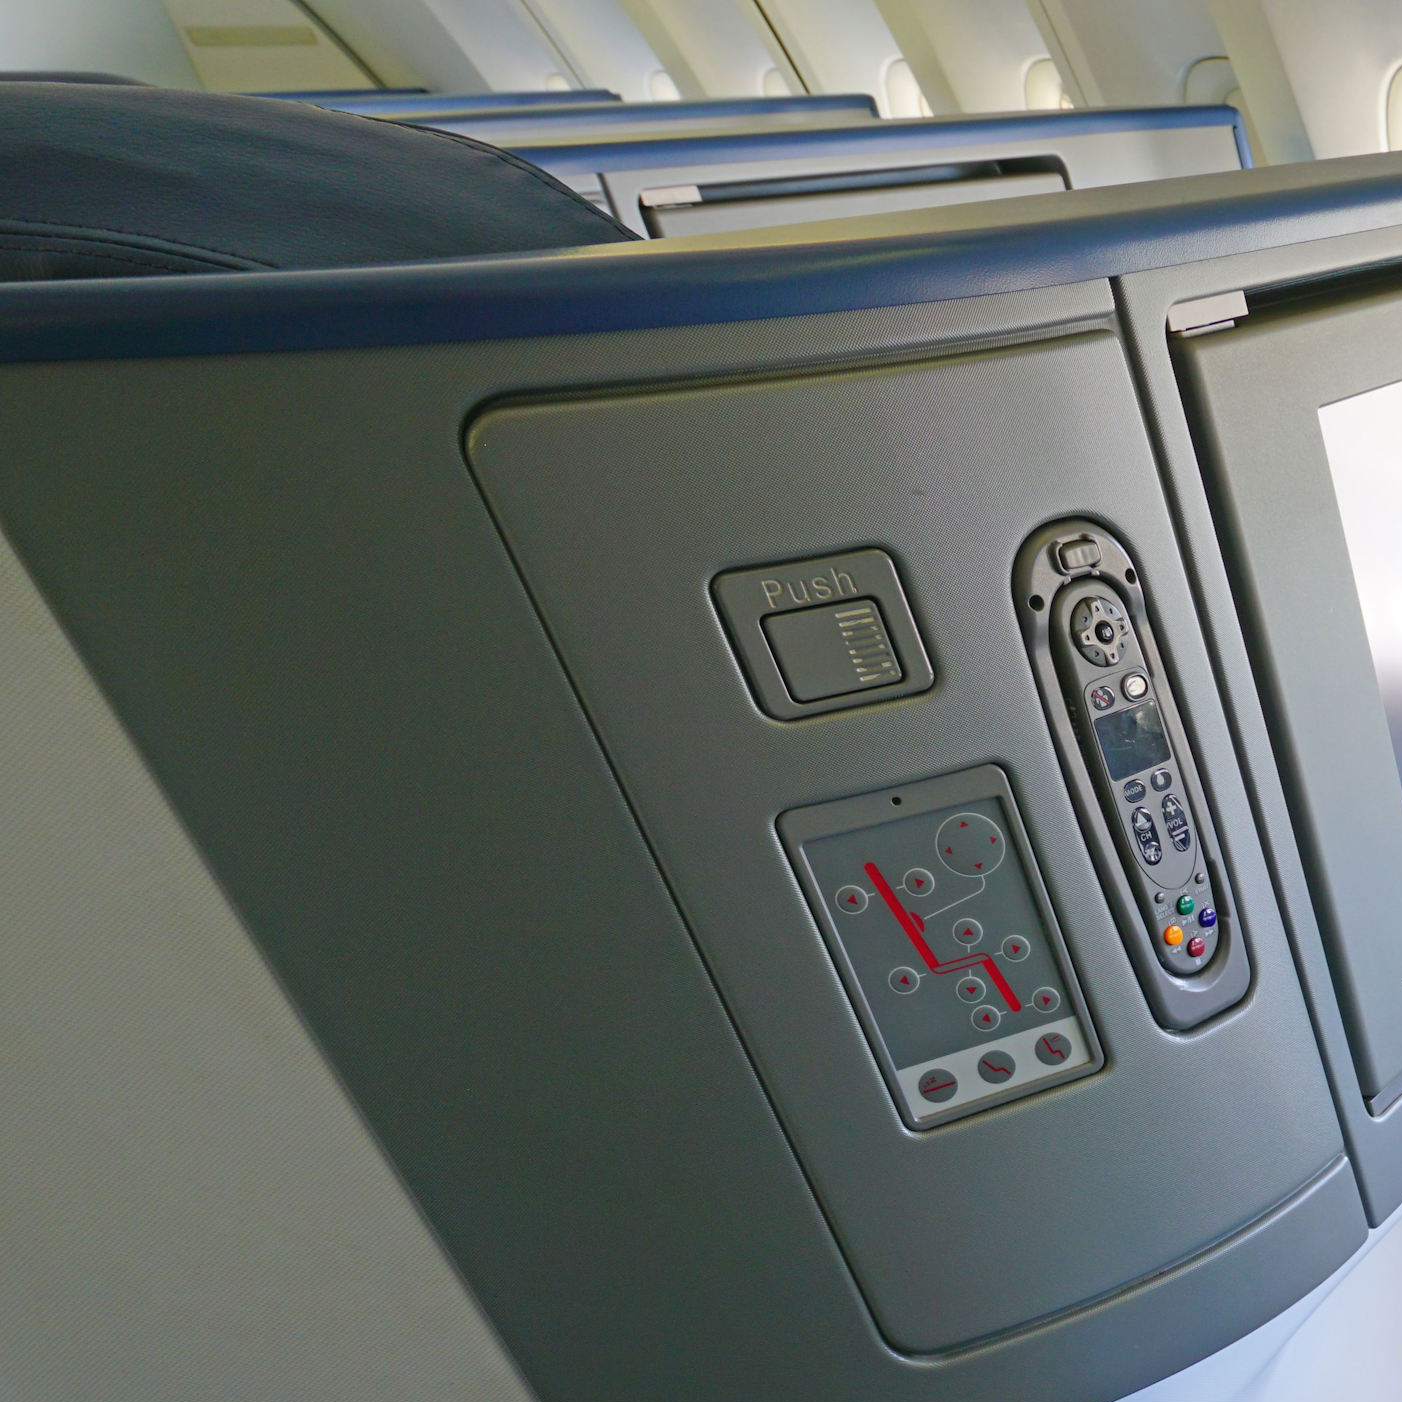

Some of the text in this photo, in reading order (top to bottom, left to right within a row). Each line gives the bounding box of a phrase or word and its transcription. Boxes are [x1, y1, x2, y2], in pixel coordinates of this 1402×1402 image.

[761, 568, 858, 608] Push
[1124, 786, 1144, 797] MODE
[1168, 818, 1184, 829] VOL
[1141, 832, 1152, 842] CH
